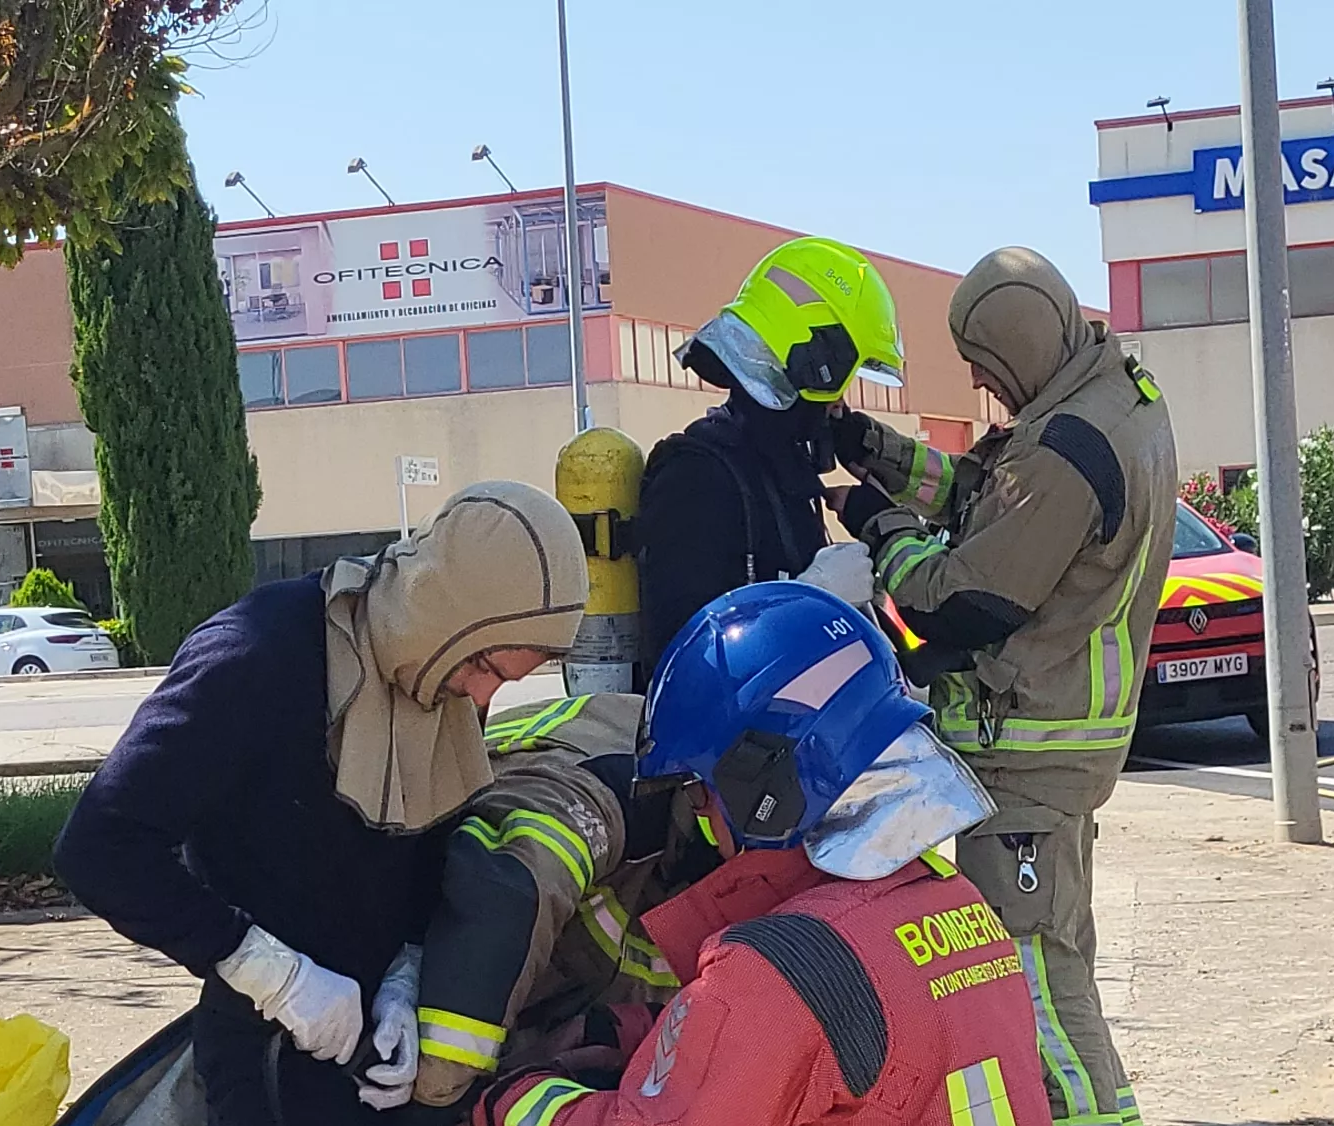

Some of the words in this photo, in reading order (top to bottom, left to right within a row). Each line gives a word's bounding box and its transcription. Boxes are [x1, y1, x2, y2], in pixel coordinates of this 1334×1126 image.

[313, 256, 504, 284] OFITECNICA
[449, 303, 459, 312] DE
[461, 300, 497, 311] OFICINAS
[1169, 660, 1207, 678] 3907
[1214, 656, 1244, 674] MYG
